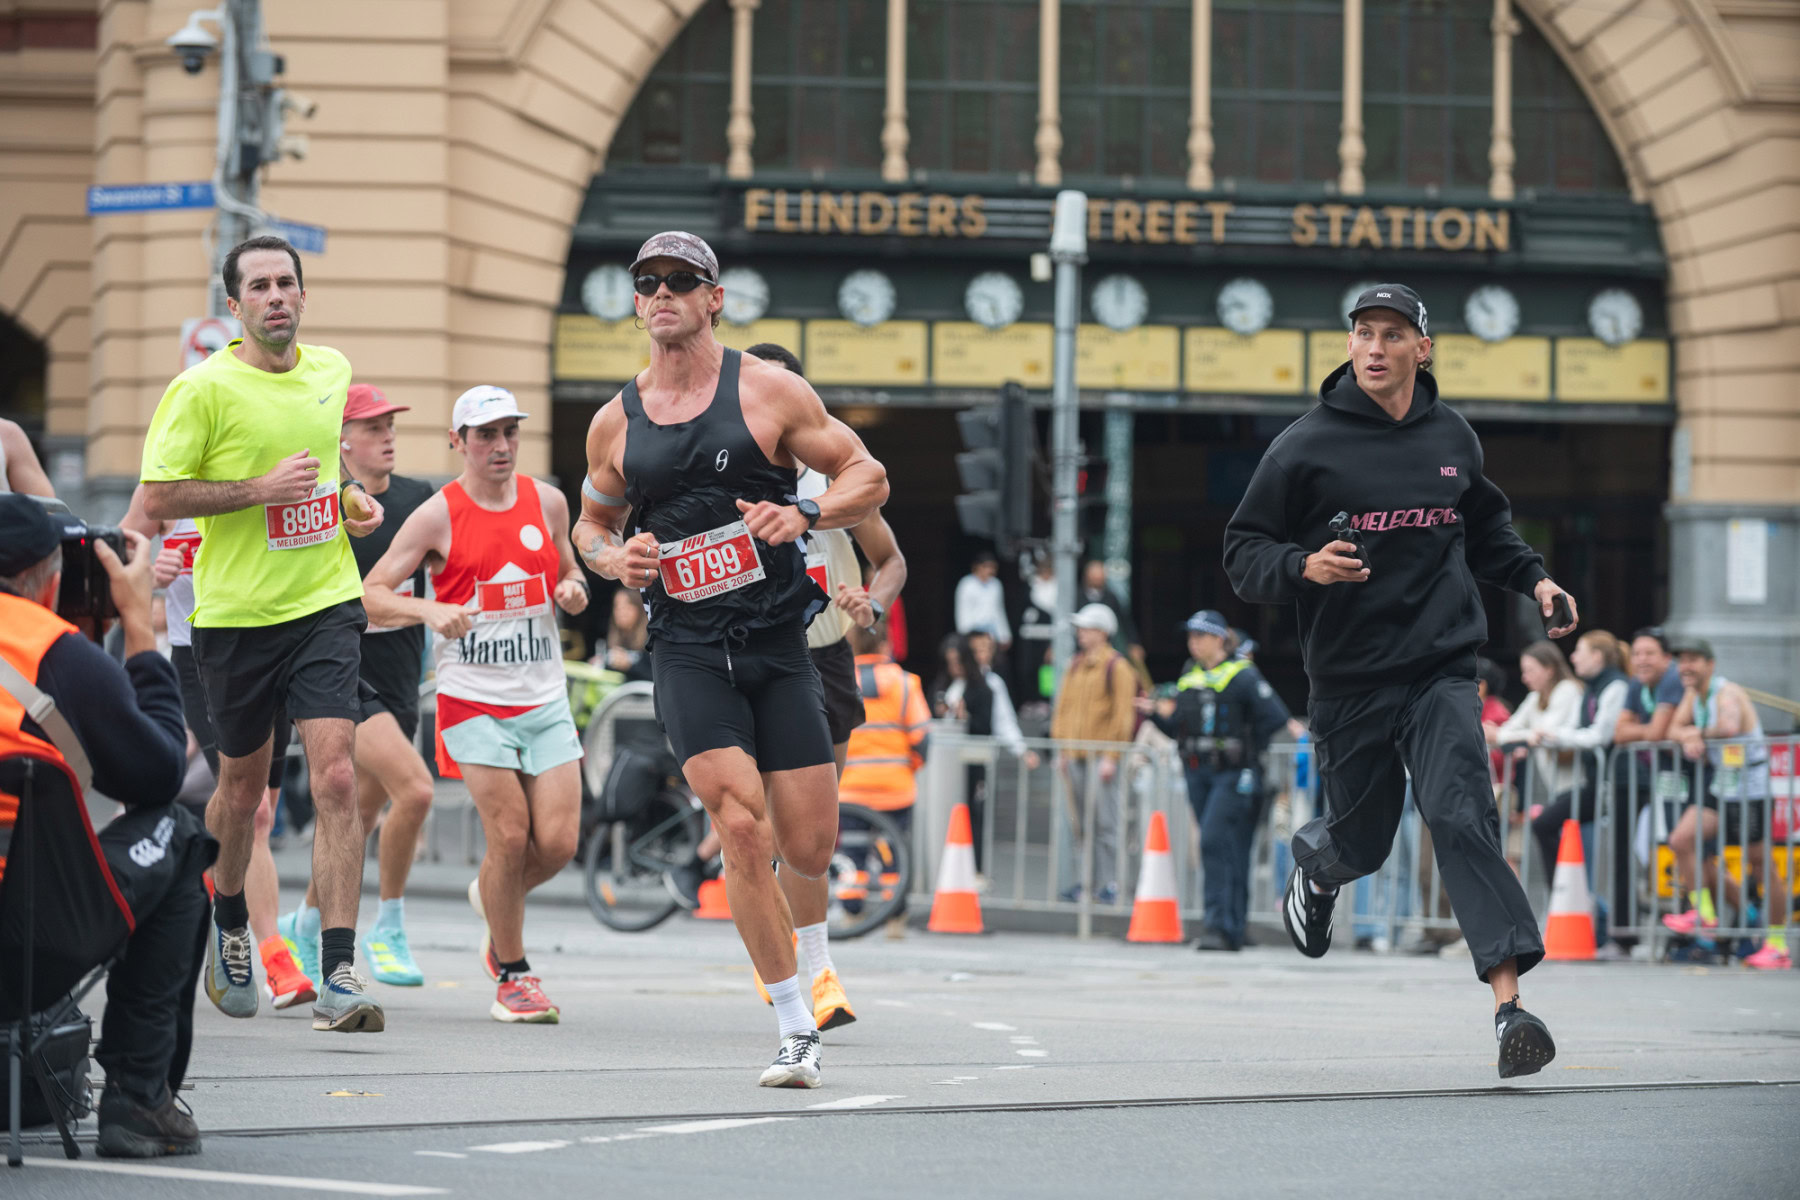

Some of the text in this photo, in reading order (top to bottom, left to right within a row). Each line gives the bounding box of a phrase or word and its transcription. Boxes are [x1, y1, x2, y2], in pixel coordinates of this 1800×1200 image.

[745, 189, 1510, 251] FLINDERS TREET STATION
[1440, 466, 1458, 477] NOX
[282, 498, 334, 535] 8964
[276, 533, 323, 548] MELBOURNE
[675, 543, 741, 589] 6799
[503, 582, 525, 597] MATT
[677, 572, 754, 602] MELBOURNE 2025
[485, 609, 525, 620] MELBOURNE
[458, 618, 552, 664] Marathn
